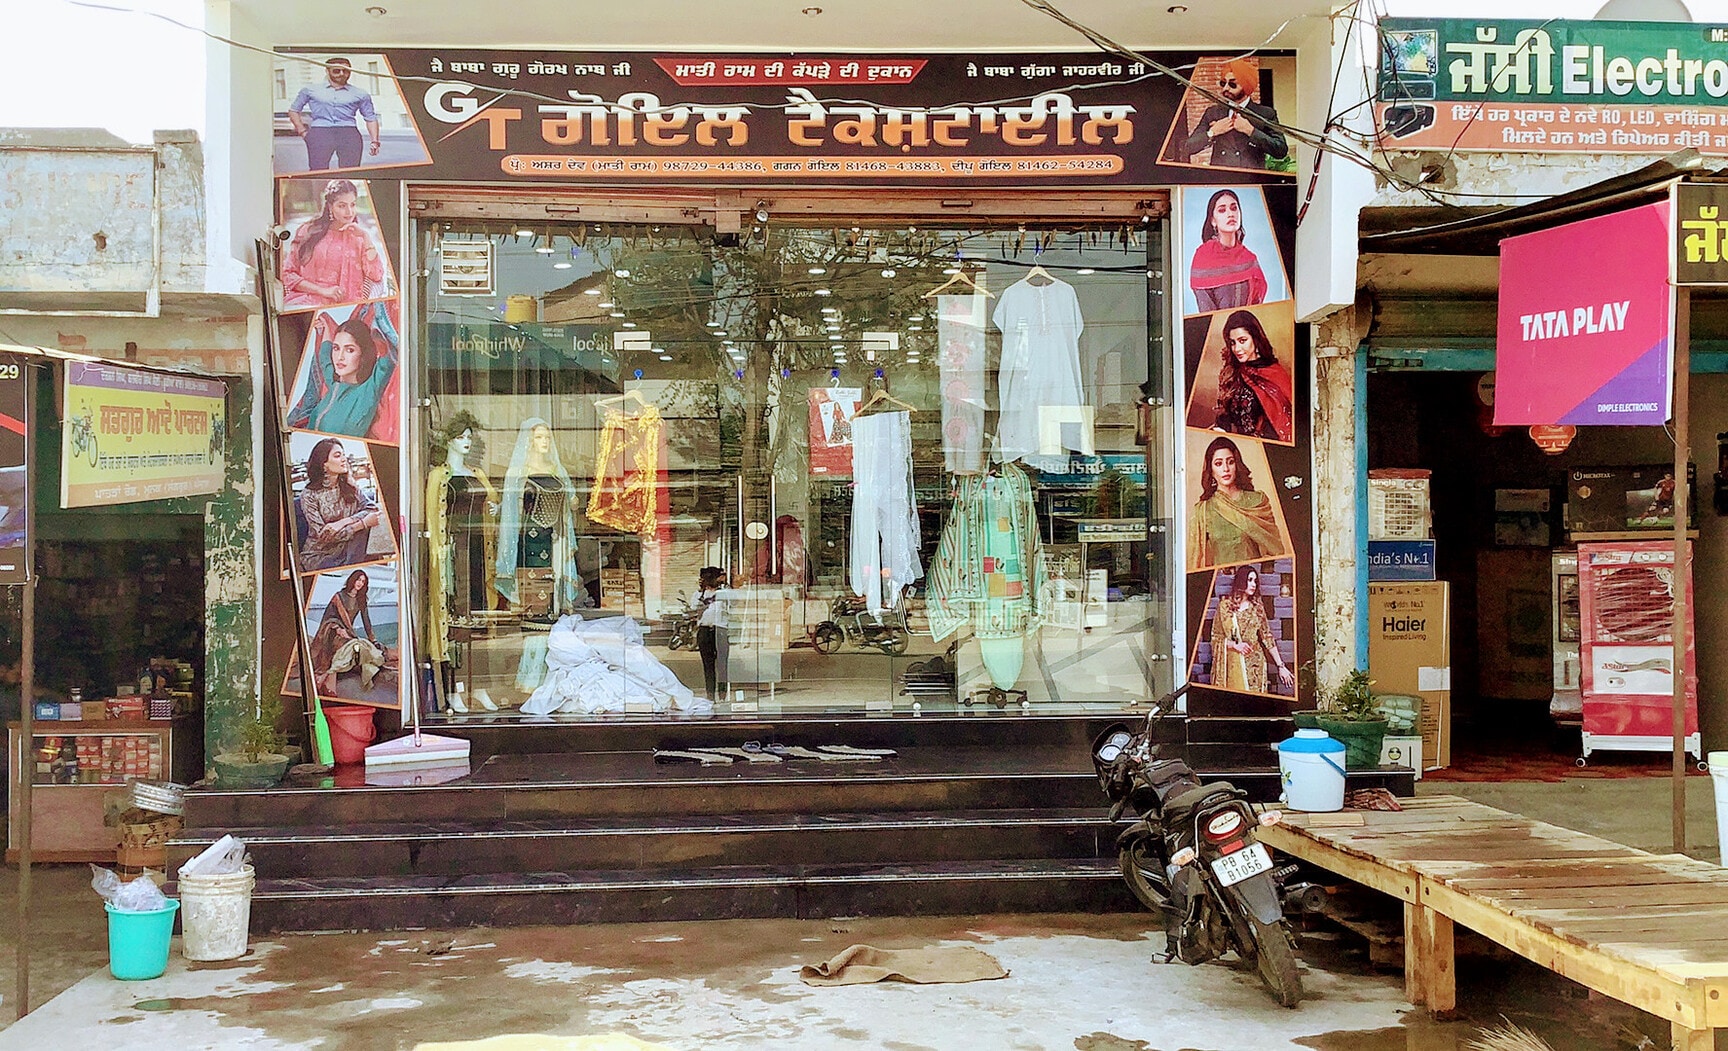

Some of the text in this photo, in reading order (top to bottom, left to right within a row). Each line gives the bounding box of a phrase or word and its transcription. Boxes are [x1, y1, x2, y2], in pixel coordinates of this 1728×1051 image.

[430, 57, 443, 73] ਜੈ
[450, 61, 485, 74] ਬਾਬਾ
[492, 62, 521, 79] ਗੁਰੂ
[612, 62, 631, 76] ਜੀ
[724, 65, 755, 77] ਰਾਮ
[764, 62, 784, 77] ਦੀ
[792, 62, 831, 79] ਕੱਪੜੇ
[839, 62, 860, 78] ਦੀ
[867, 65, 913, 81] ਦੁਕਾਨ
[966, 62, 978, 77] ਜੈ
[984, 65, 1014, 77] ਬਾਬਾ
[1128, 62, 1145, 76] ਜੀ
[1446, 27, 1728, 97] ਜੱਸੀ Electro
[538, 89, 752, 147] ਗੋਇਲ
[1488, 109, 1510, 122] ਹਰ
[1559, 106, 1571, 123] ਦੇ
[1602, 109, 1627, 127] RO,
[1630, 109, 1660, 127] LED,
[1502, 127, 1546, 144] ਮਿਲਦੇ
[1550, 131, 1574, 145] ਹਨ
[1578, 128, 1607, 145] ਅਤੇ
[1673, 130, 1710, 147] ਕੀਤੀ
[1520, 301, 1631, 342] TATA PLAY
[1598, 402, 1659, 413] DIMPLE ELECTRONICS
[1368, 552, 1401, 565] ndia's
[1382, 615, 1426, 632] Haier
[1222, 856, 1237, 870] PB
